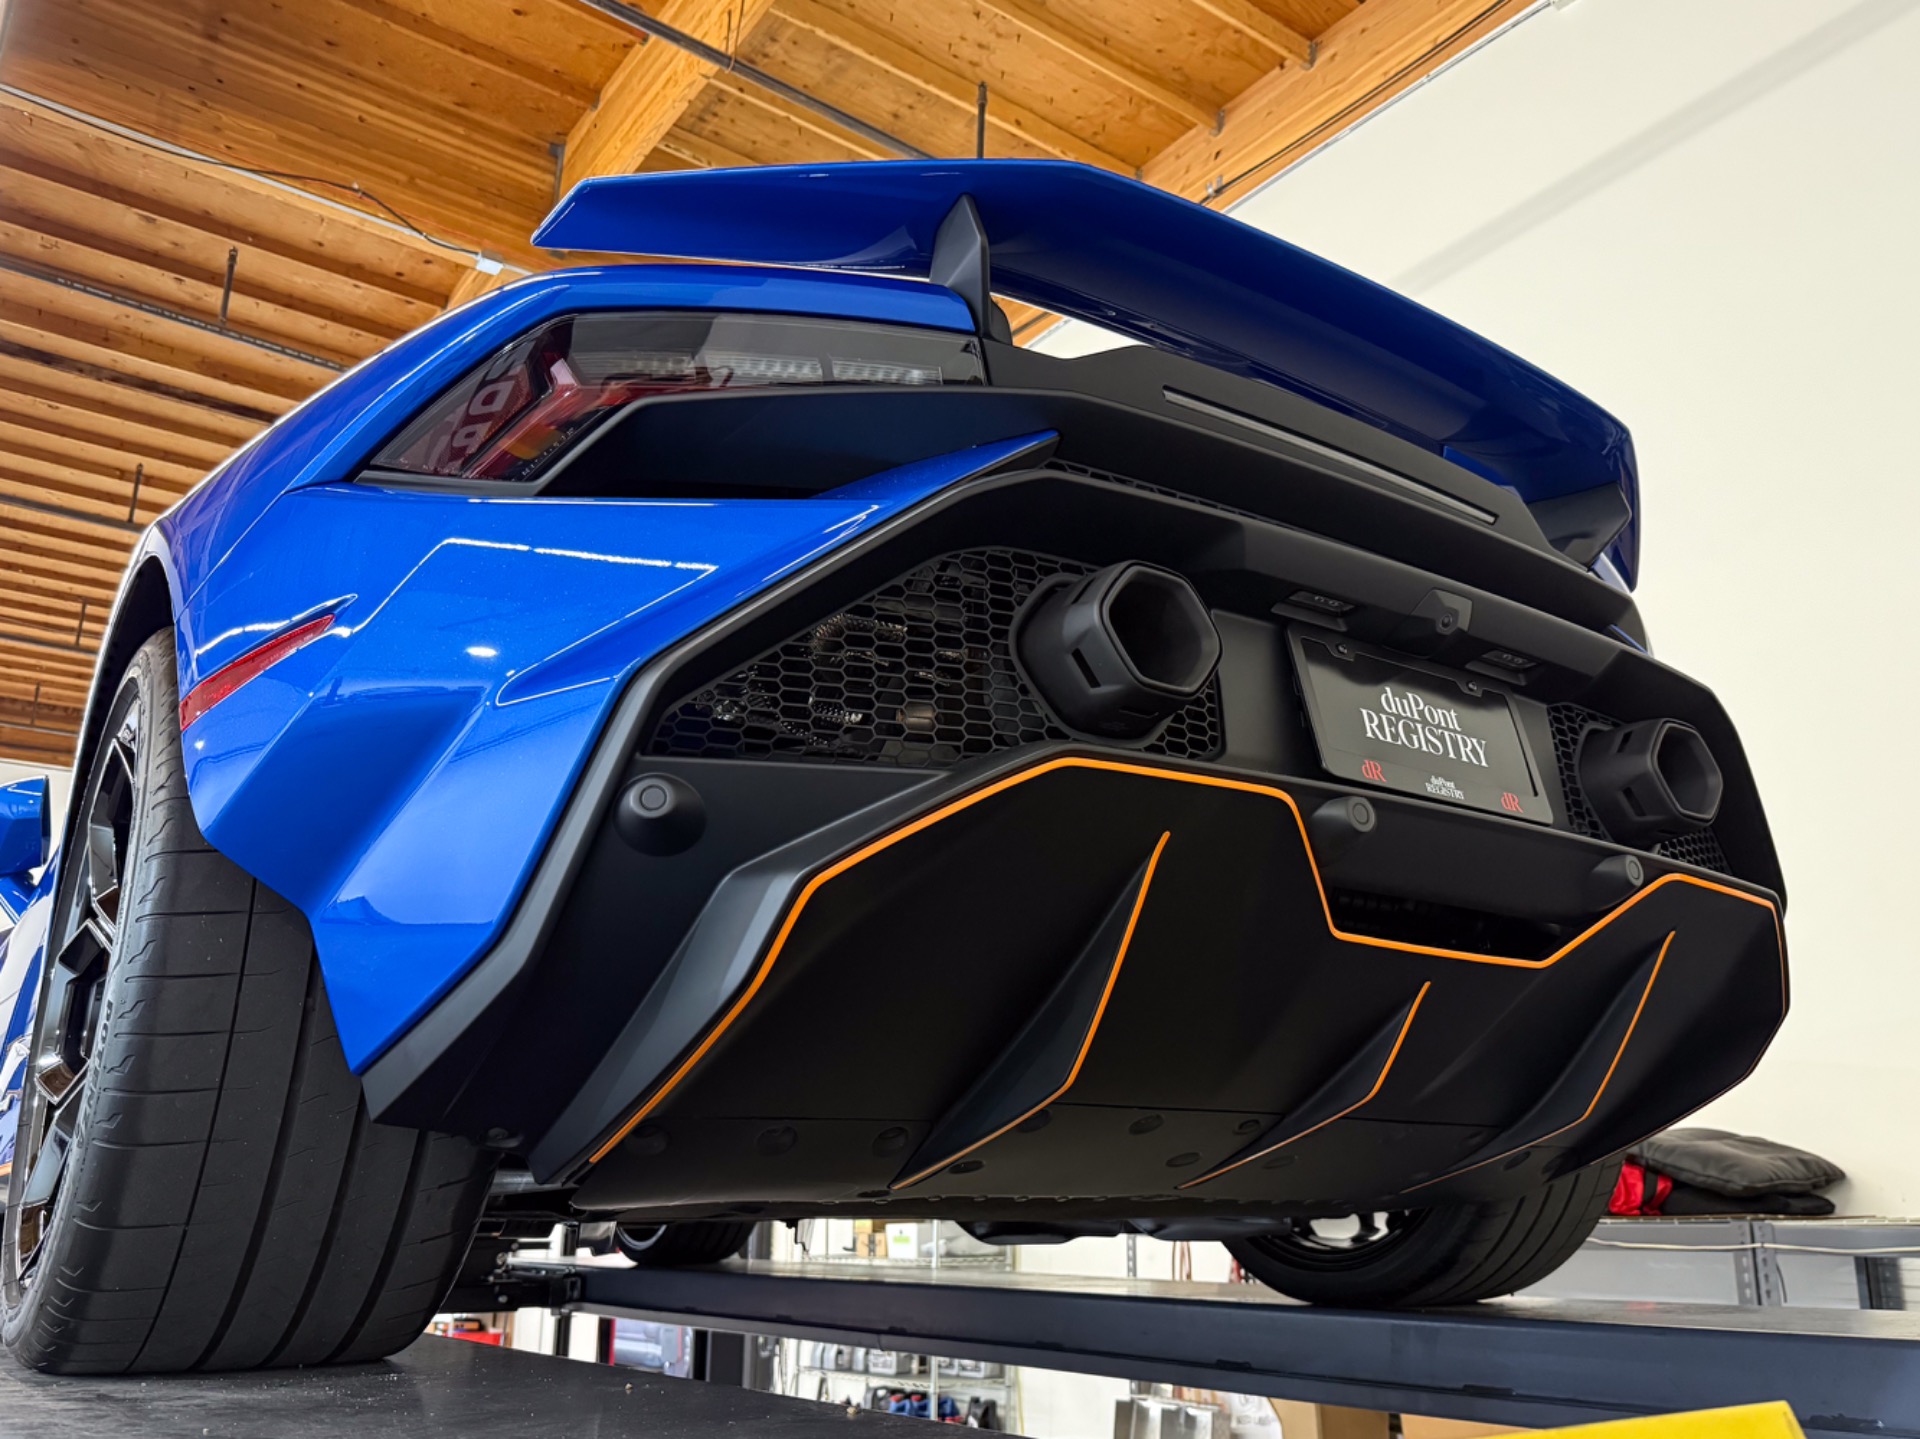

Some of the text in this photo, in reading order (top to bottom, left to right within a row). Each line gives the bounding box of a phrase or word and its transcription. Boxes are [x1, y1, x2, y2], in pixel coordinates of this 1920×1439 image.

[1380, 686, 1462, 731] duPont
[1360, 707, 1489, 767] REGISTRY
[1361, 759, 1387, 783] dR
[1431, 775, 1456, 788] duPont
[1424, 782, 1465, 800] REGISTRY
[1501, 792, 1524, 813] dR
